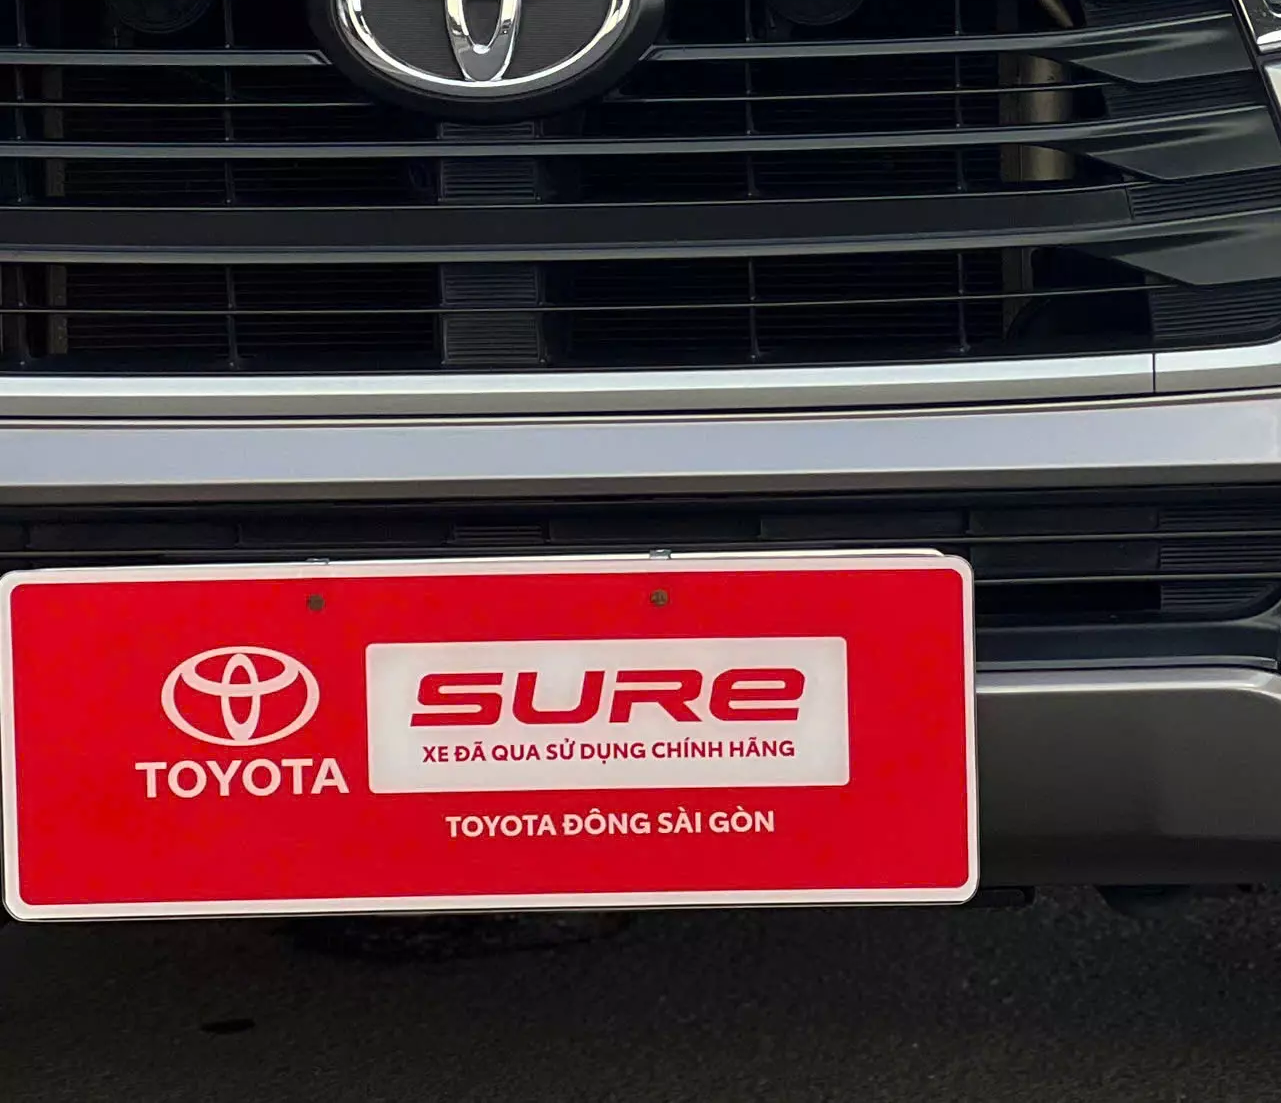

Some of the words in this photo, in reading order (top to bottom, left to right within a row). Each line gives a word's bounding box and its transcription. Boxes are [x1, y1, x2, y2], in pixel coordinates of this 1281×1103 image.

[422, 745, 449, 763] XE
[453, 741, 487, 763] ĐÃ
[491, 744, 541, 764] QUA
[546, 738, 576, 761] SỬ
[580, 742, 646, 765] DỤNG
[651, 736, 723, 759] CHÍNH
[729, 738, 795, 758] HÃNG
[135, 758, 350, 799] TOYOTA
[446, 813, 557, 838] TOYOTA
[562, 808, 651, 836] ĐÔNG
[657, 806, 702, 834] SÀI
[708, 805, 775, 833] GÒN
